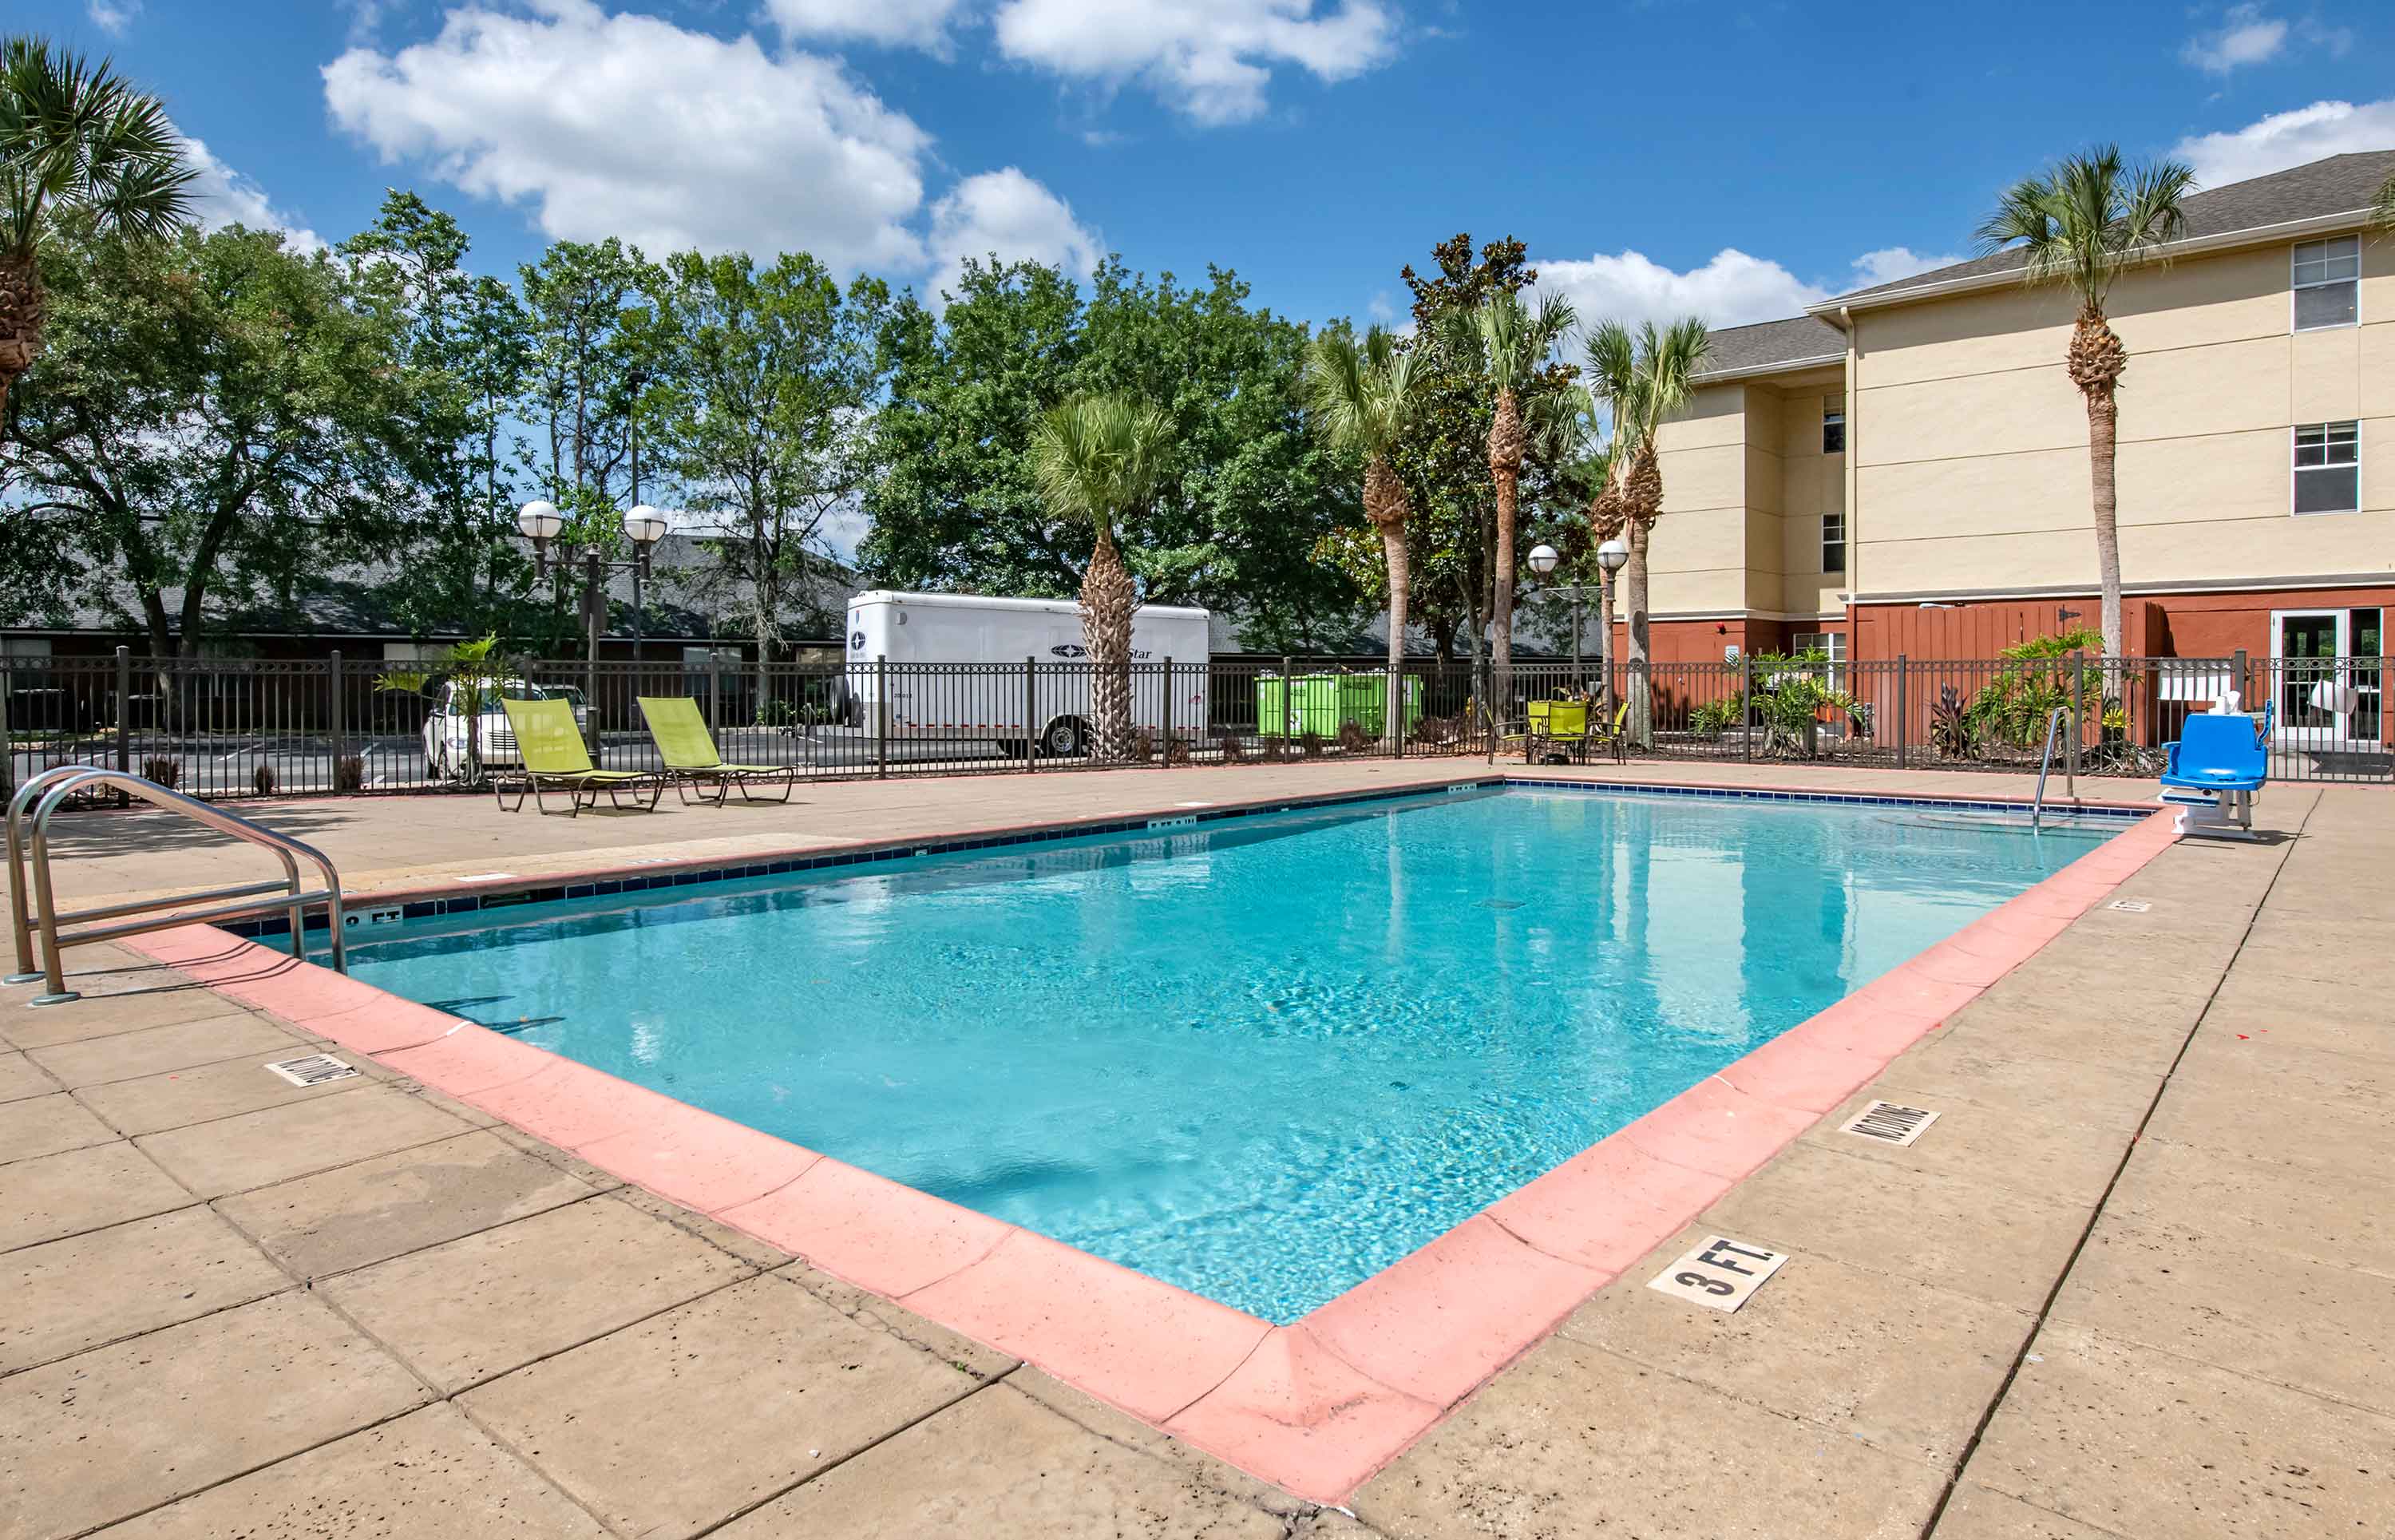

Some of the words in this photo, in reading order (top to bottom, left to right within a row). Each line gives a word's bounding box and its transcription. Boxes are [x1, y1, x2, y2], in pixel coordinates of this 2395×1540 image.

[1861, 1103, 1930, 1132] DIVING
[1850, 1123, 1906, 1142] NO
[1696, 1239, 1775, 1277] FT.
[1675, 1272, 1736, 1296] 3
